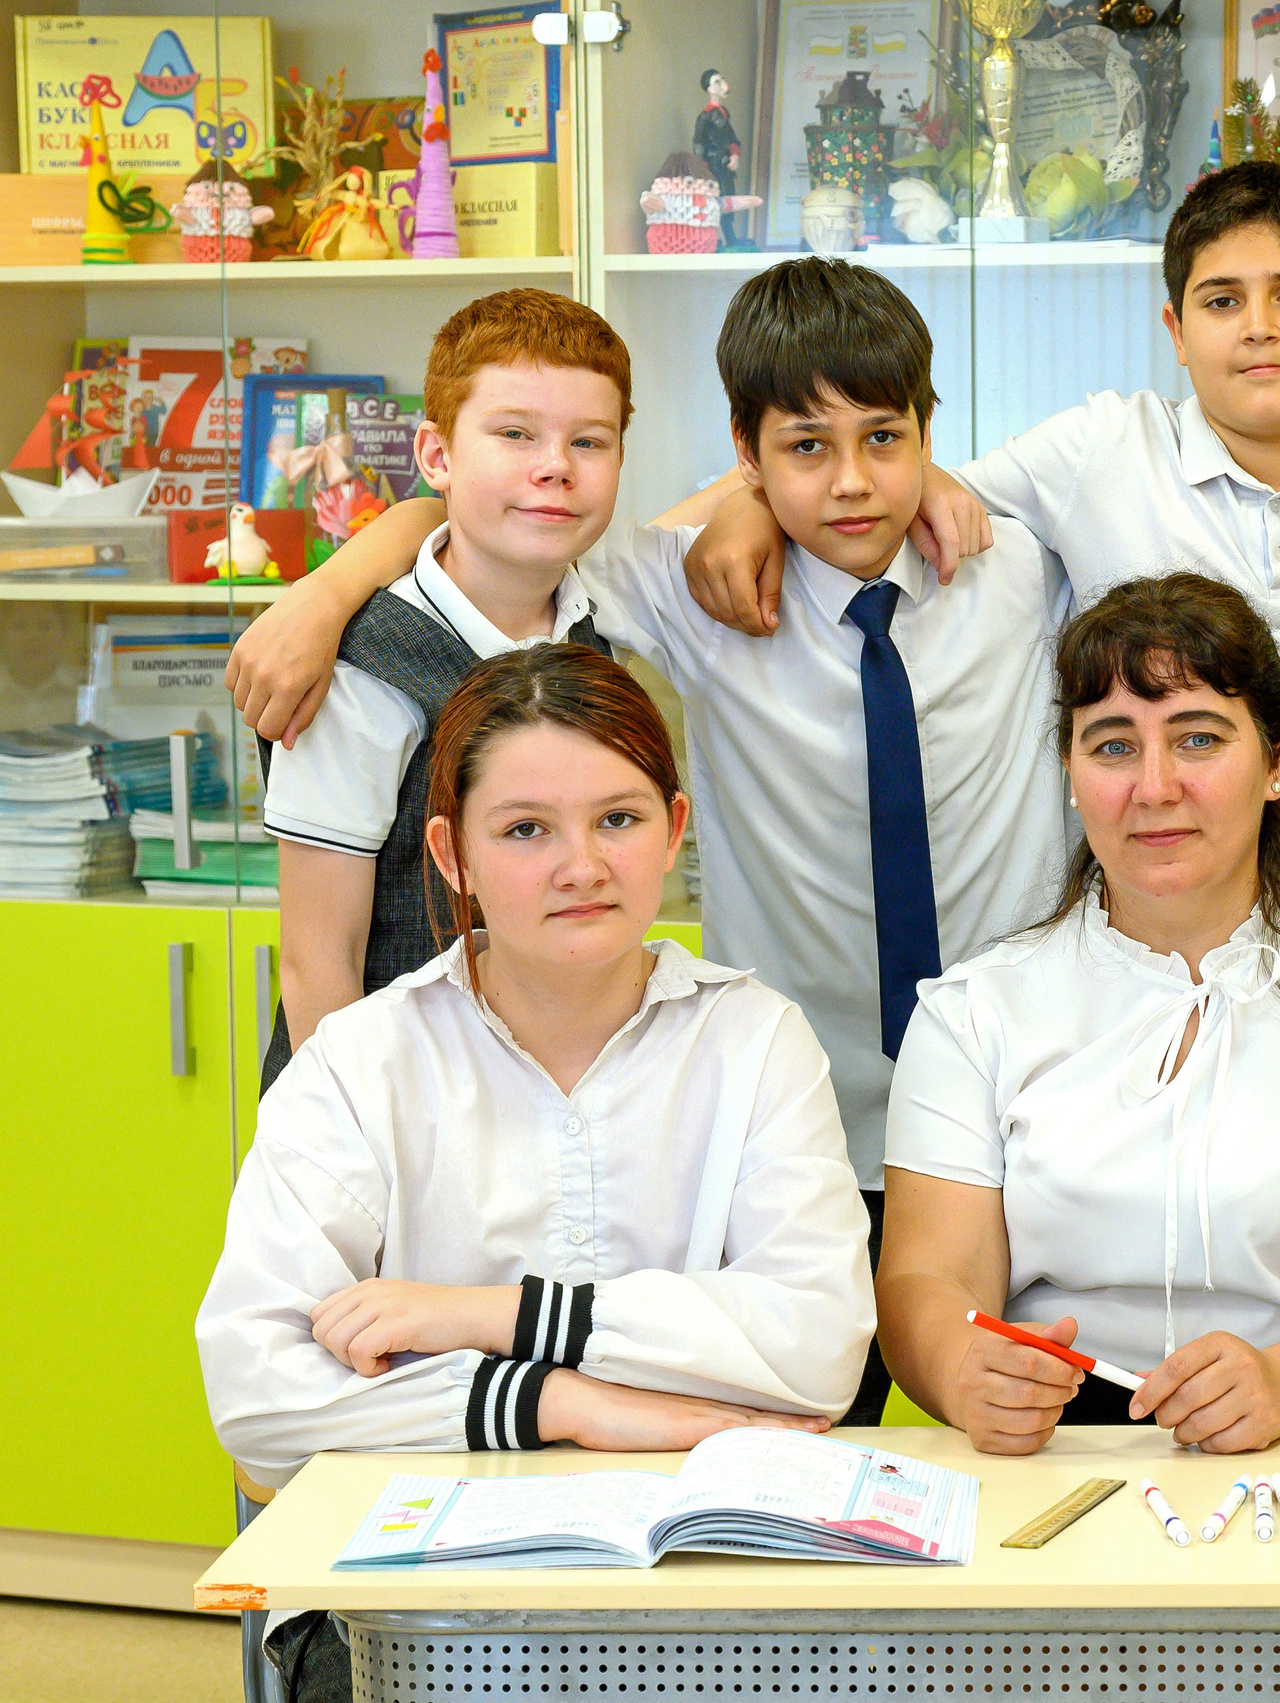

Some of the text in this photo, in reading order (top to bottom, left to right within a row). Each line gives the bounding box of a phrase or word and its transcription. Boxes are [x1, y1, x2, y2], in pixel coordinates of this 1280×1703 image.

[37, 107, 92, 124] БУК
[138, 348, 226, 448] 7
[351, 430, 407, 443] РАВИЛА
[354, 455, 408, 466] ЕМАТИКЕ
[158, 674, 213, 687] ПИСЬМО
